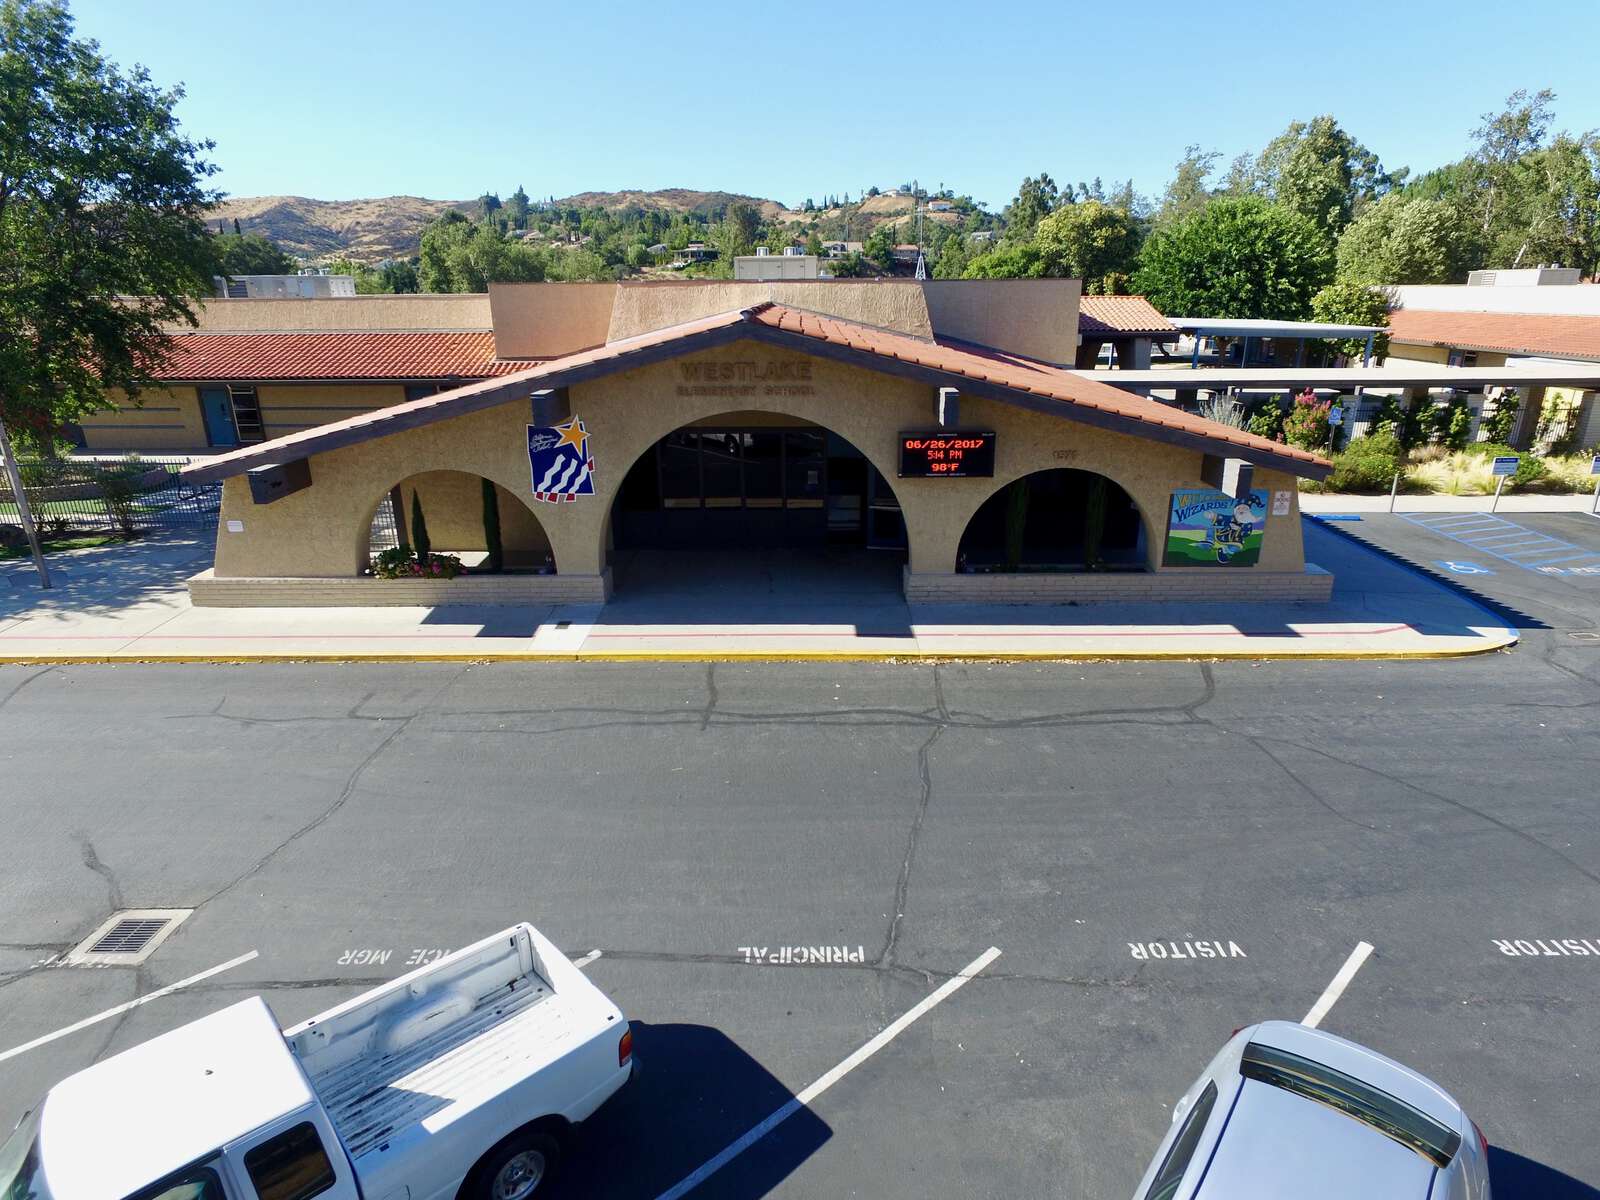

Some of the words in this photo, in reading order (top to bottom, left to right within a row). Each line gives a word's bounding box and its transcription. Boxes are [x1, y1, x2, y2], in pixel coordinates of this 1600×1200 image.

[680, 361, 813, 382] WESTLAKE
[905, 440, 984, 449] 06/26/2017
[927, 450, 945, 460] 5:14
[949, 450, 963, 460] PM
[737, 945, 866, 964] PRINCIPAL
[1127, 940, 1248, 960] VISITOR
[1490, 939, 1600, 956] ISITOR
[336, 949, 393, 965] MGR
